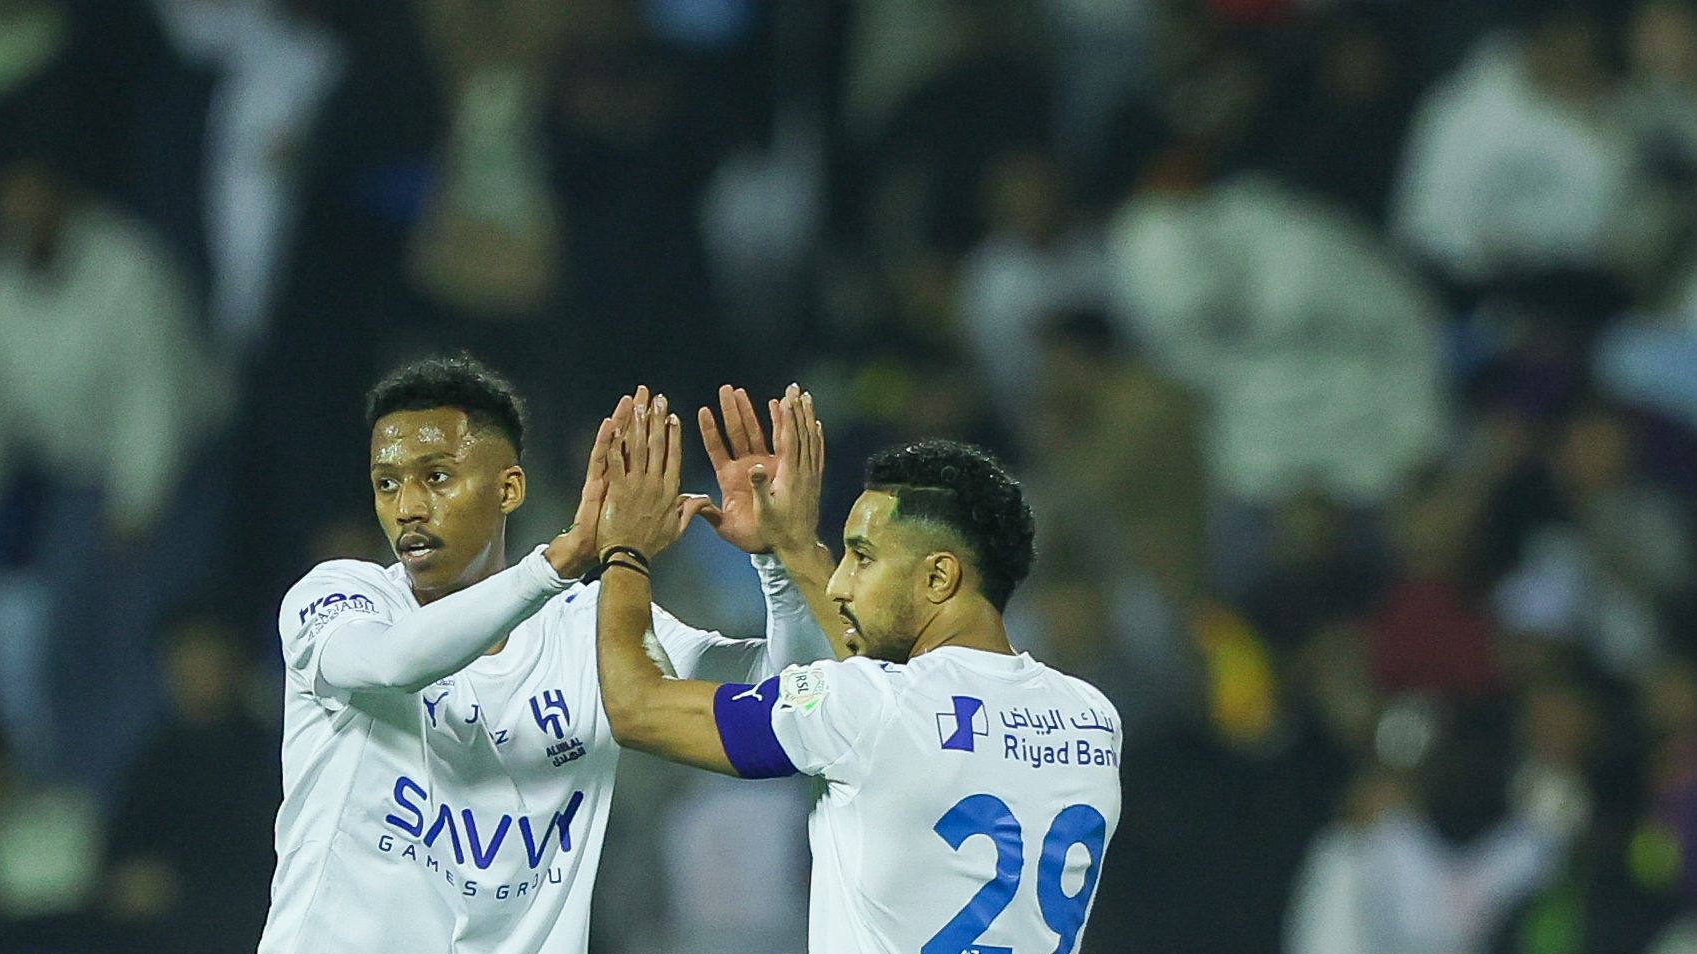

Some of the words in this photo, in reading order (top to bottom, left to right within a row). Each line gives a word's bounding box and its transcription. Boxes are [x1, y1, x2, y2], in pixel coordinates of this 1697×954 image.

[999, 707, 1066, 736] الرياض
[1004, 734, 1070, 769] Riyad
[385, 776, 584, 870] SAVVY
[378, 835, 478, 896] GAMES
